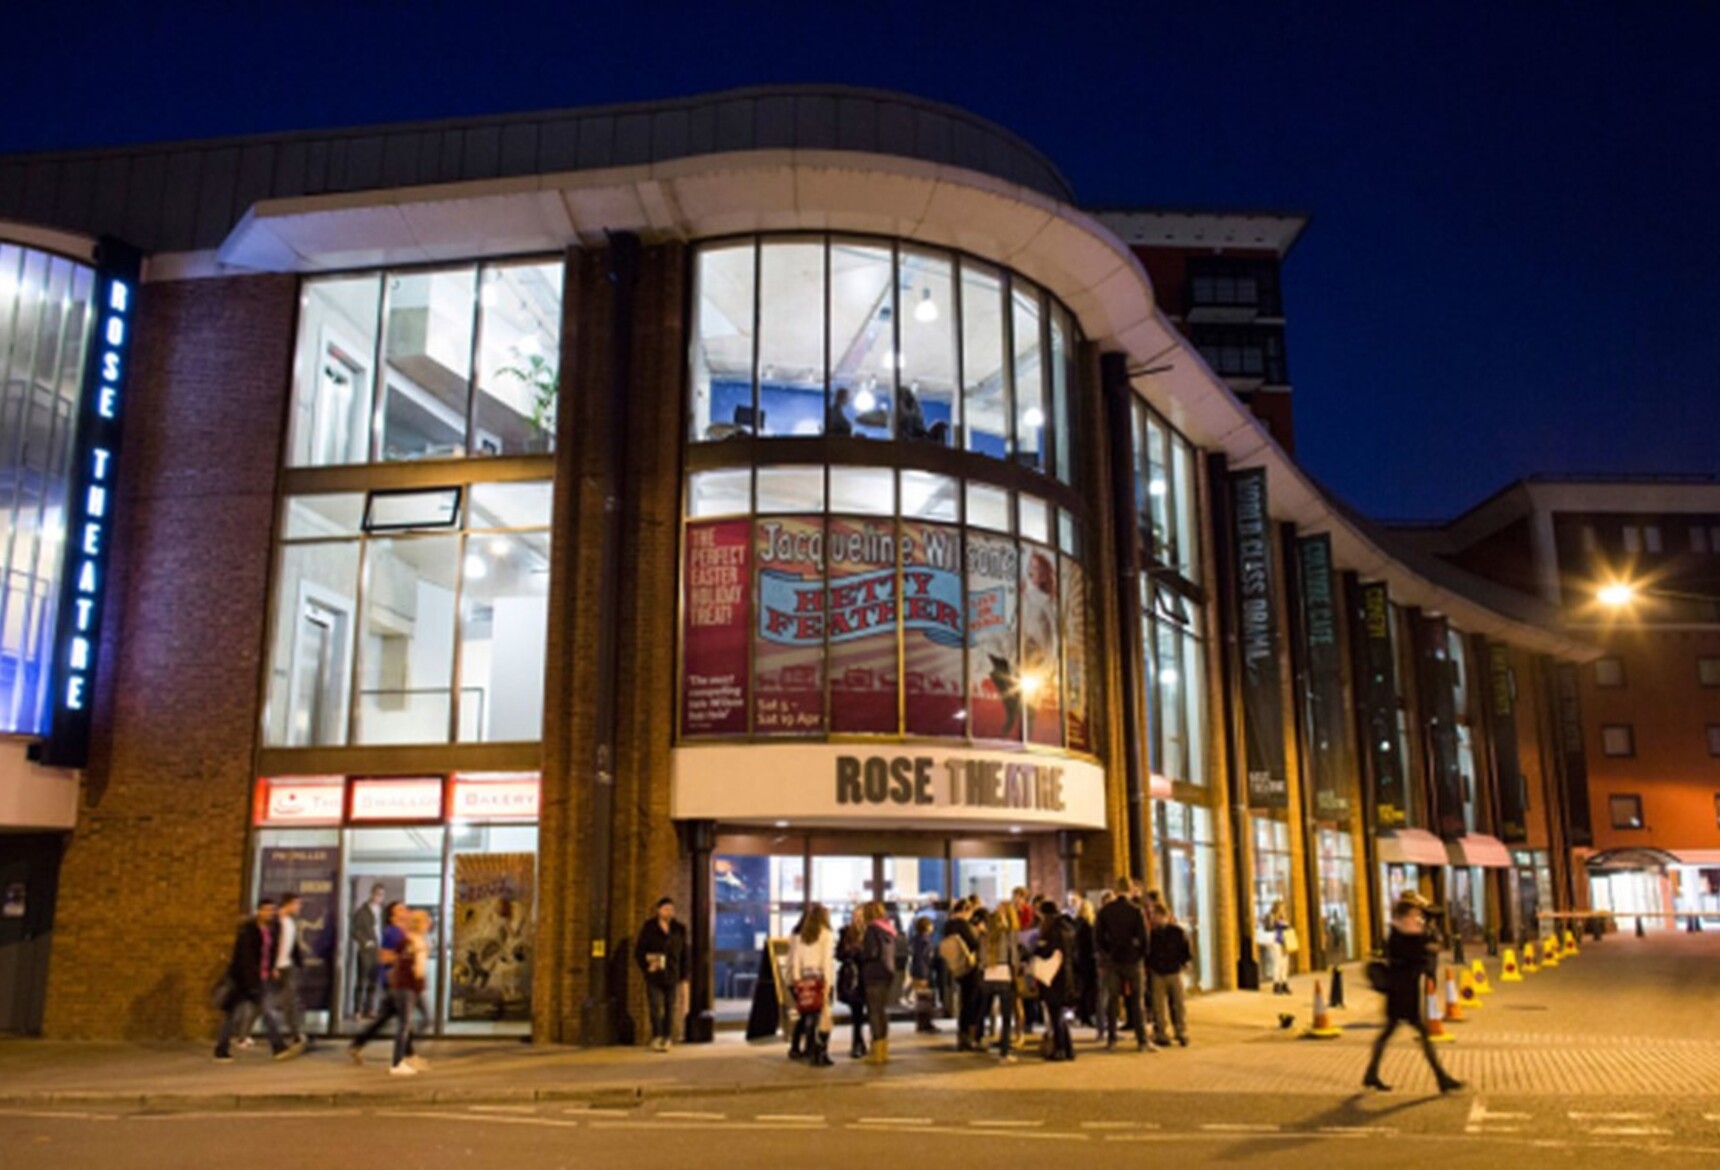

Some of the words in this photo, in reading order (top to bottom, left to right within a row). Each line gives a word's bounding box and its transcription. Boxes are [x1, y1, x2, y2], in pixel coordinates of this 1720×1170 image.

[97, 279, 129, 419] ROSE
[690, 526, 717, 548] THE
[690, 545, 747, 566] PERFECT
[760, 520, 914, 573] Jacqueline
[65, 448, 111, 711] THEATRE
[690, 565, 738, 587] EASTER
[1240, 538, 1267, 596] CLASS
[690, 585, 743, 606] HOLIDAY
[794, 571, 936, 614] HETTY
[765, 597, 963, 641] FEATHER
[758, 699, 778, 711] Sat
[758, 713, 778, 725] Sat
[797, 711, 821, 728] Apr
[835, 756, 934, 806] ROSE
[944, 759, 1068, 813] THEATRE
